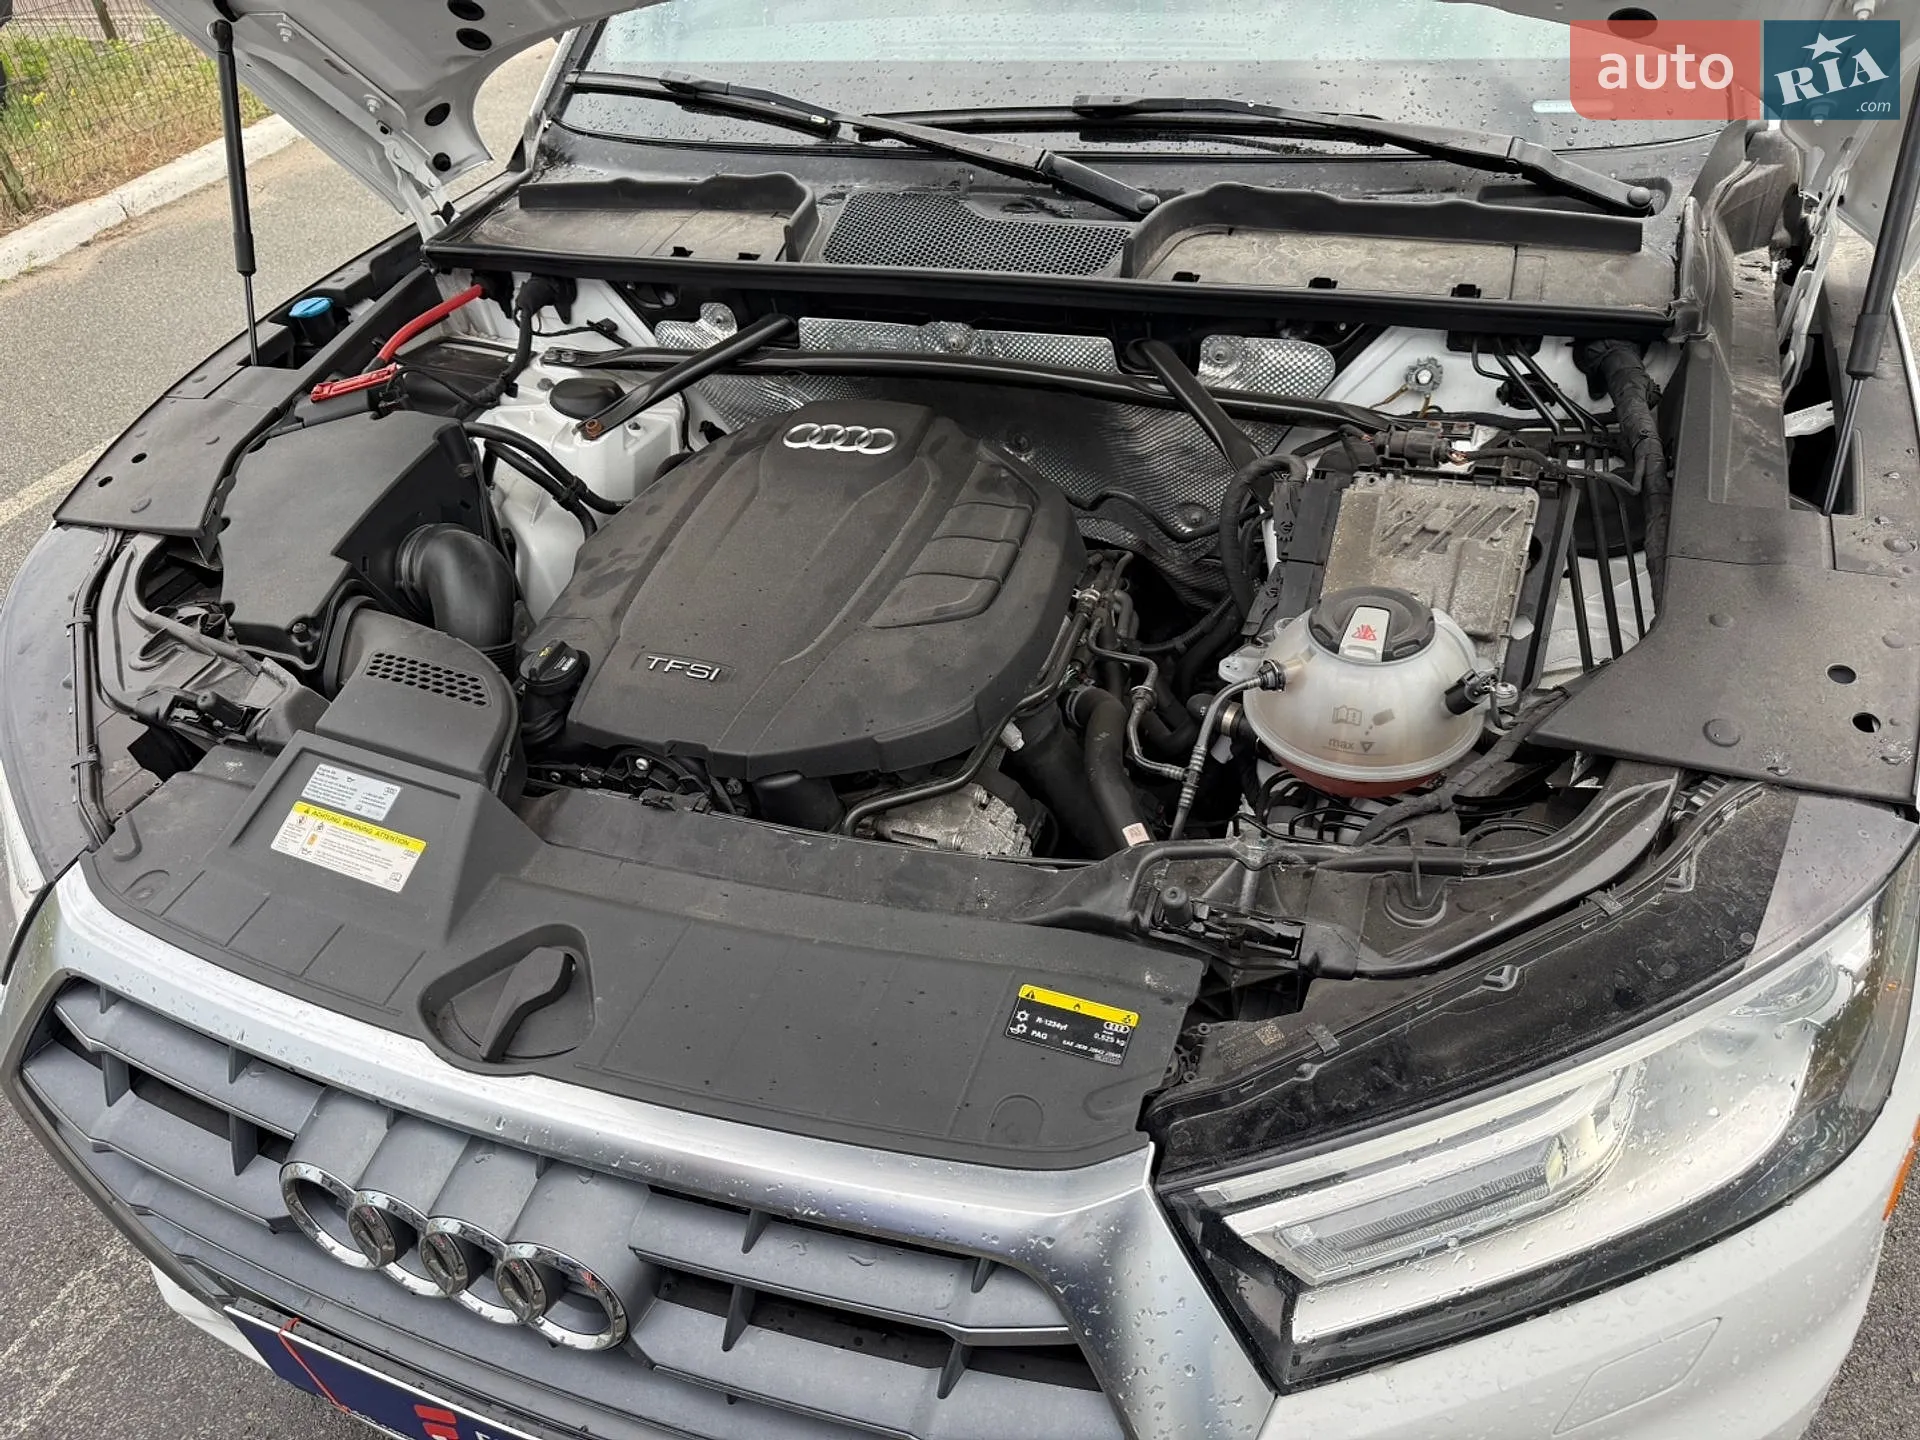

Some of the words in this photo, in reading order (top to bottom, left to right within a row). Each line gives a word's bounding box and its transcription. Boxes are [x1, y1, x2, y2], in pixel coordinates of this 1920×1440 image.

[647, 655, 721, 682] TFSI
[1328, 738, 1355, 750] max
[312, 811, 341, 824] ACHTUNG
[342, 821, 373, 835] WARNING
[375, 832, 410, 846] ATTENTION
[1036, 1017, 1068, 1031] R-1234yf
[1031, 1030, 1048, 1040] PAG
